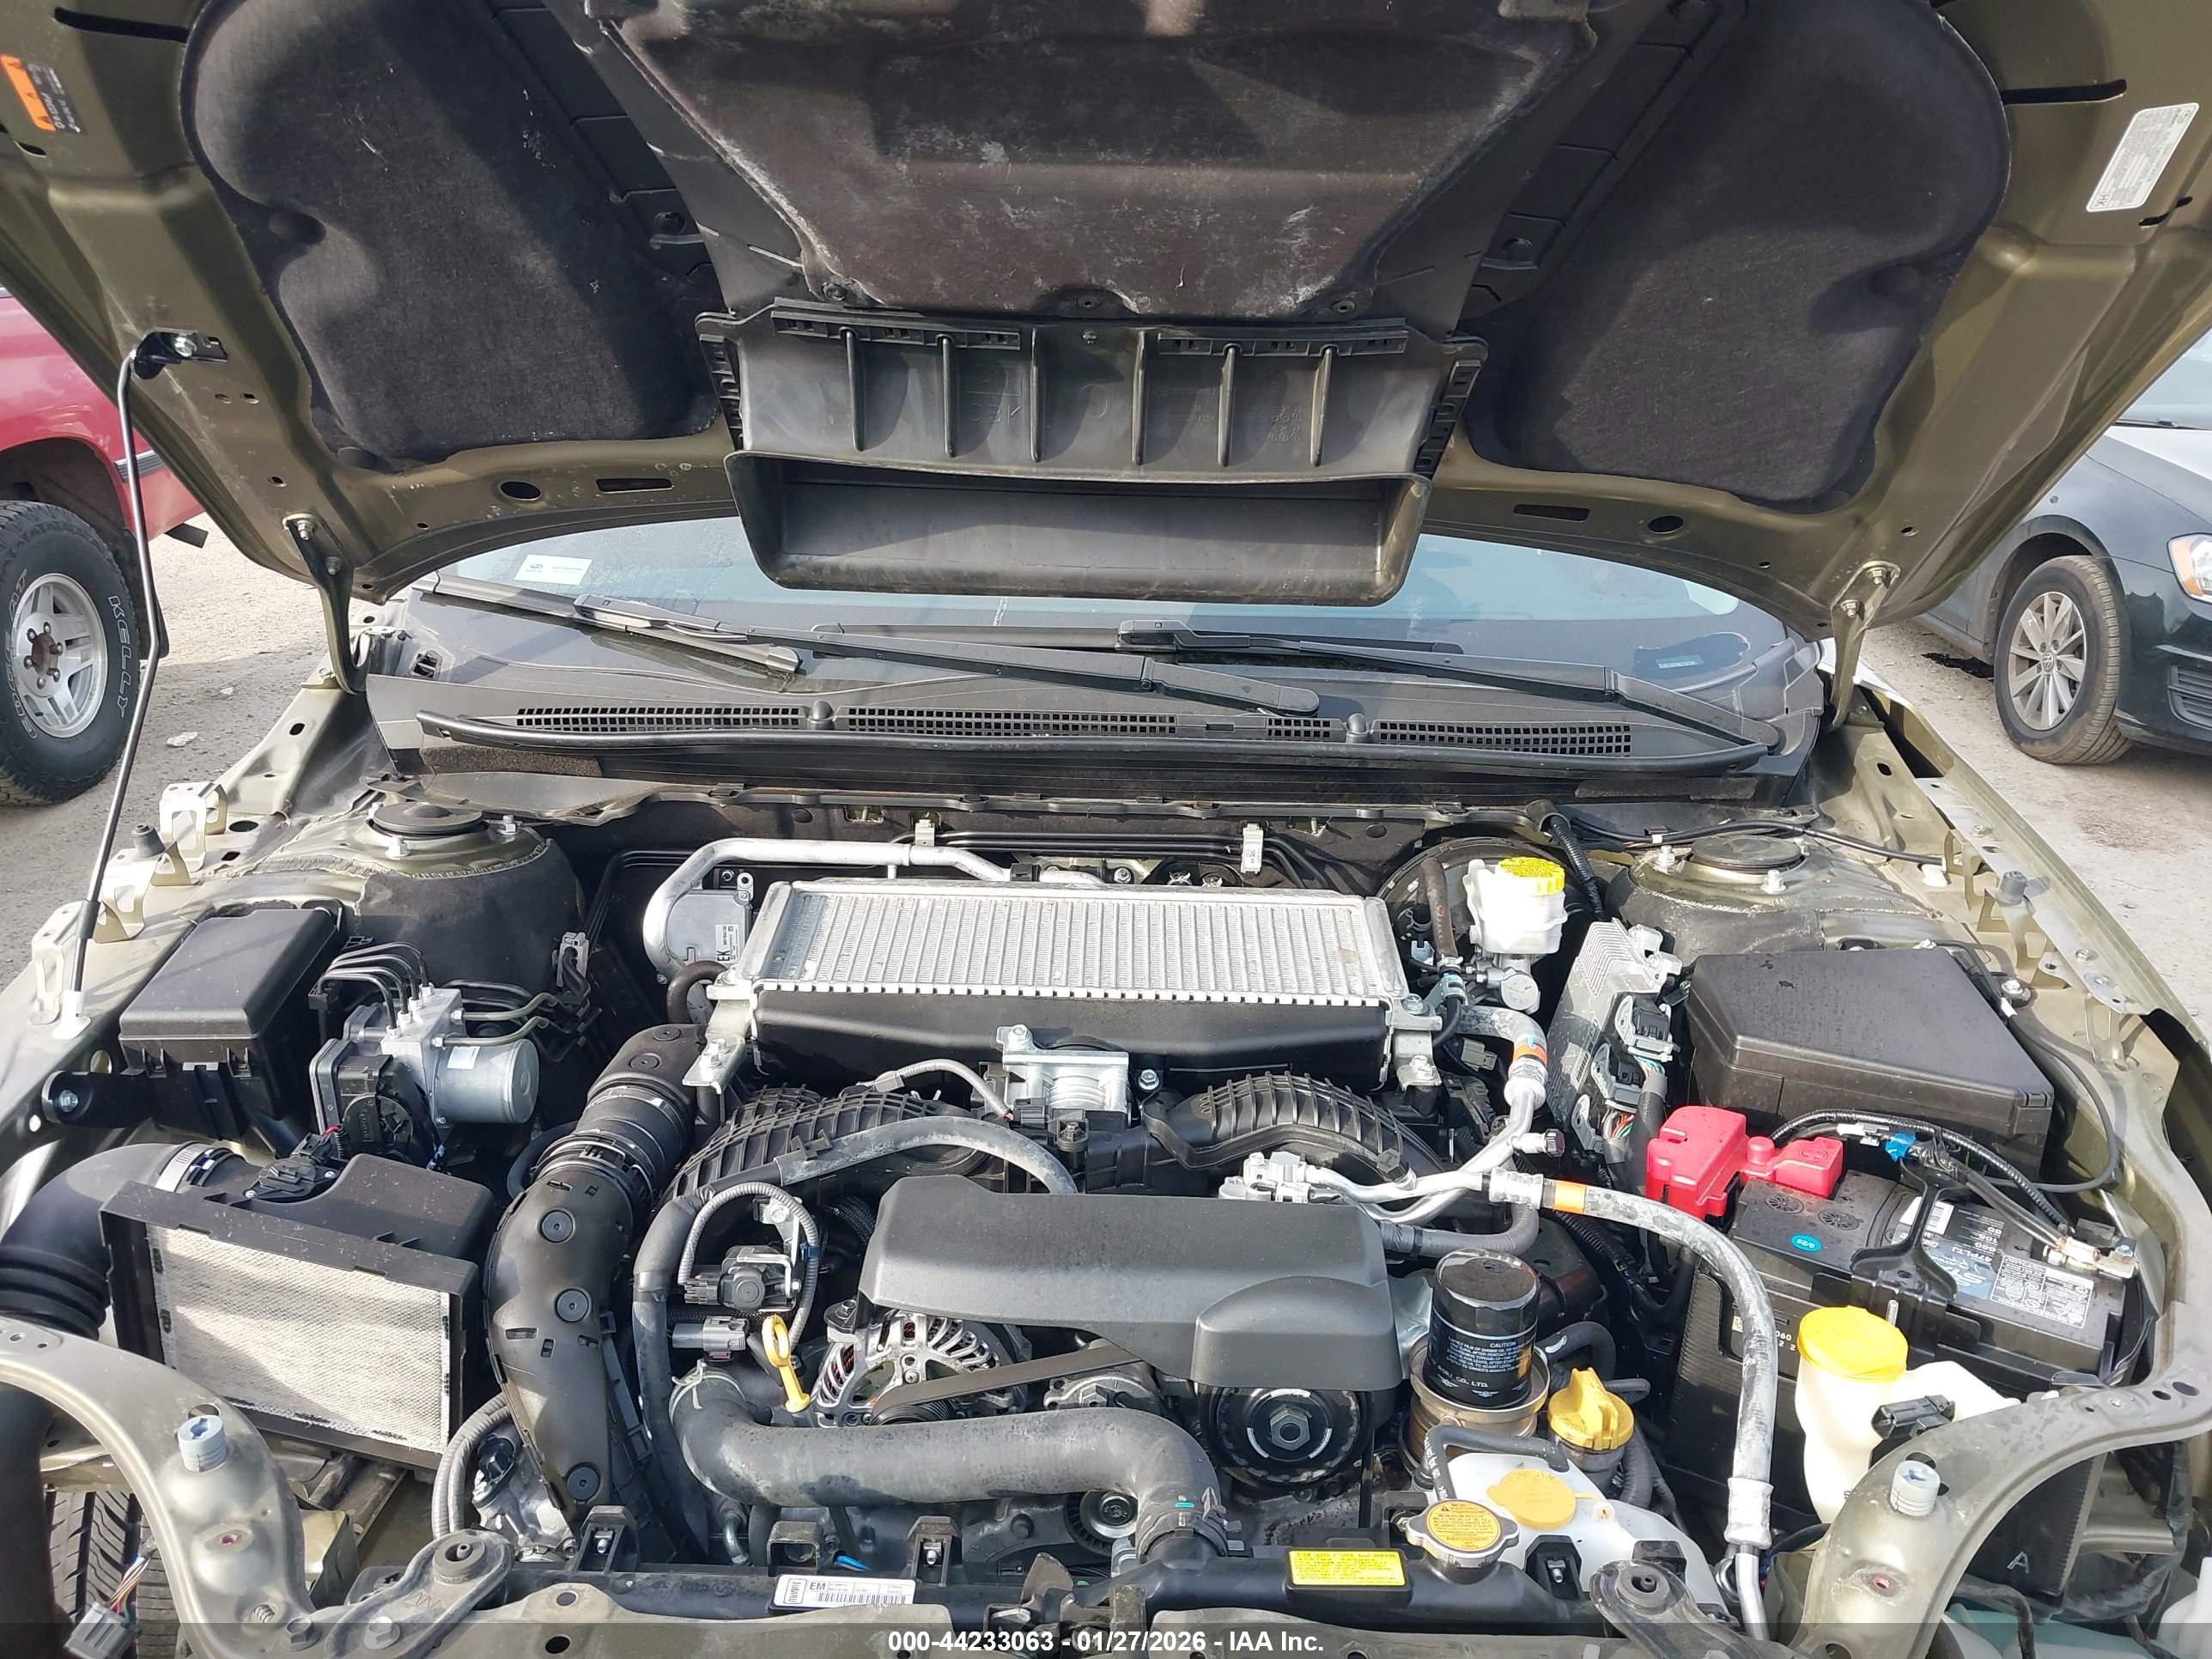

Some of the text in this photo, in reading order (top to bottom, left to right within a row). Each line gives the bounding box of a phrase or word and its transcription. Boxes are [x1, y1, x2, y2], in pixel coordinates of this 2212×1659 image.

[107, 595, 132, 718] KELLY
[716, 950, 730, 962] EK
[1952, 1246, 1993, 1262] 47PLTJ
[2007, 1551, 2030, 1574] A
[787, 1581, 801, 1603] SUBARU
[809, 1582, 826, 1591] EM
